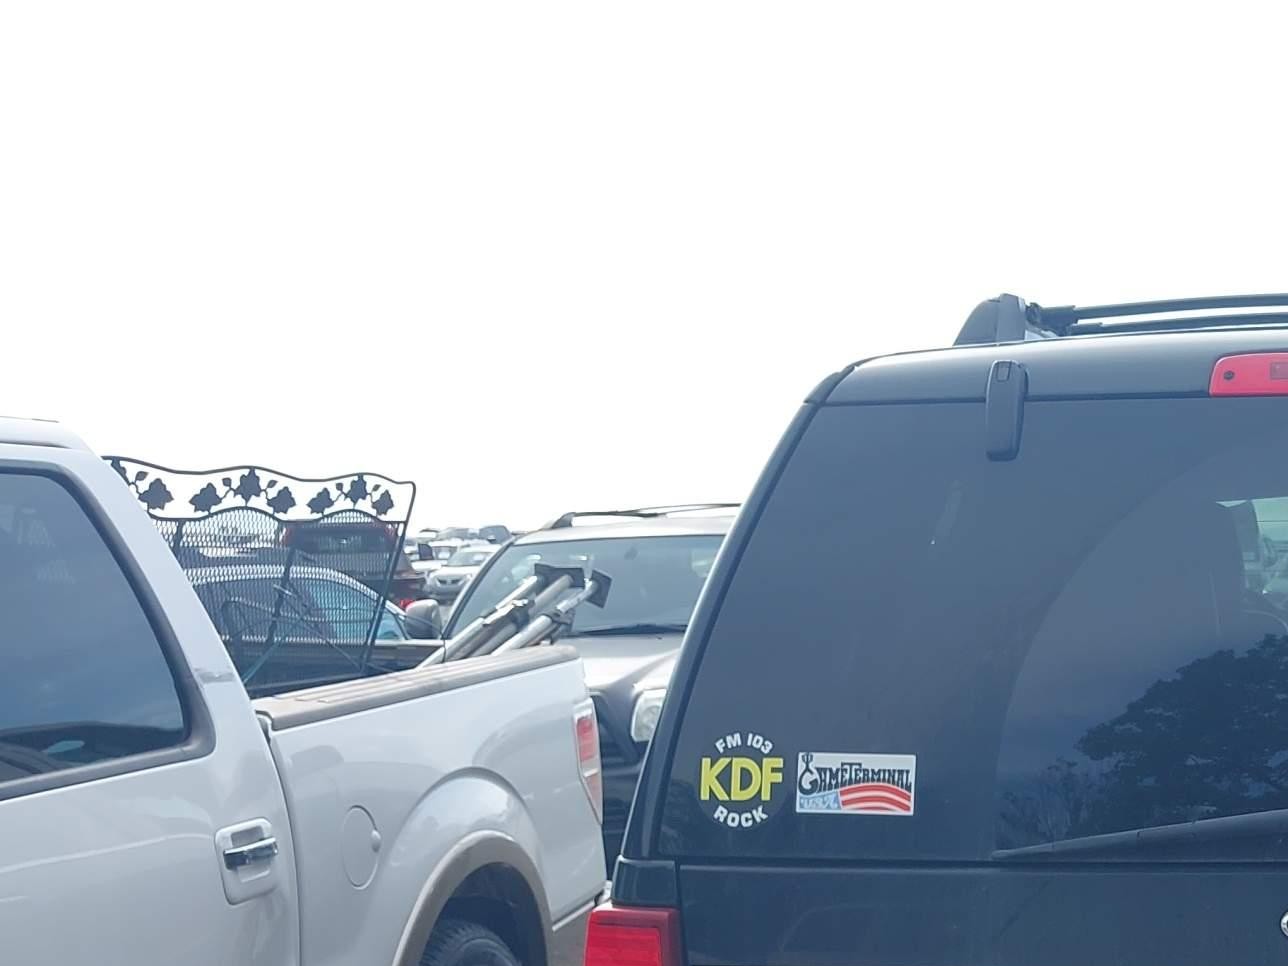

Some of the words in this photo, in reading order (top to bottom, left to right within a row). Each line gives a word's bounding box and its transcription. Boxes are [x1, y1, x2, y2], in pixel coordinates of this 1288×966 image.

[715, 733, 742, 754] FM
[747, 733, 773, 754] 103
[700, 757, 784, 801] KDF
[713, 805, 769, 828] ROCK
